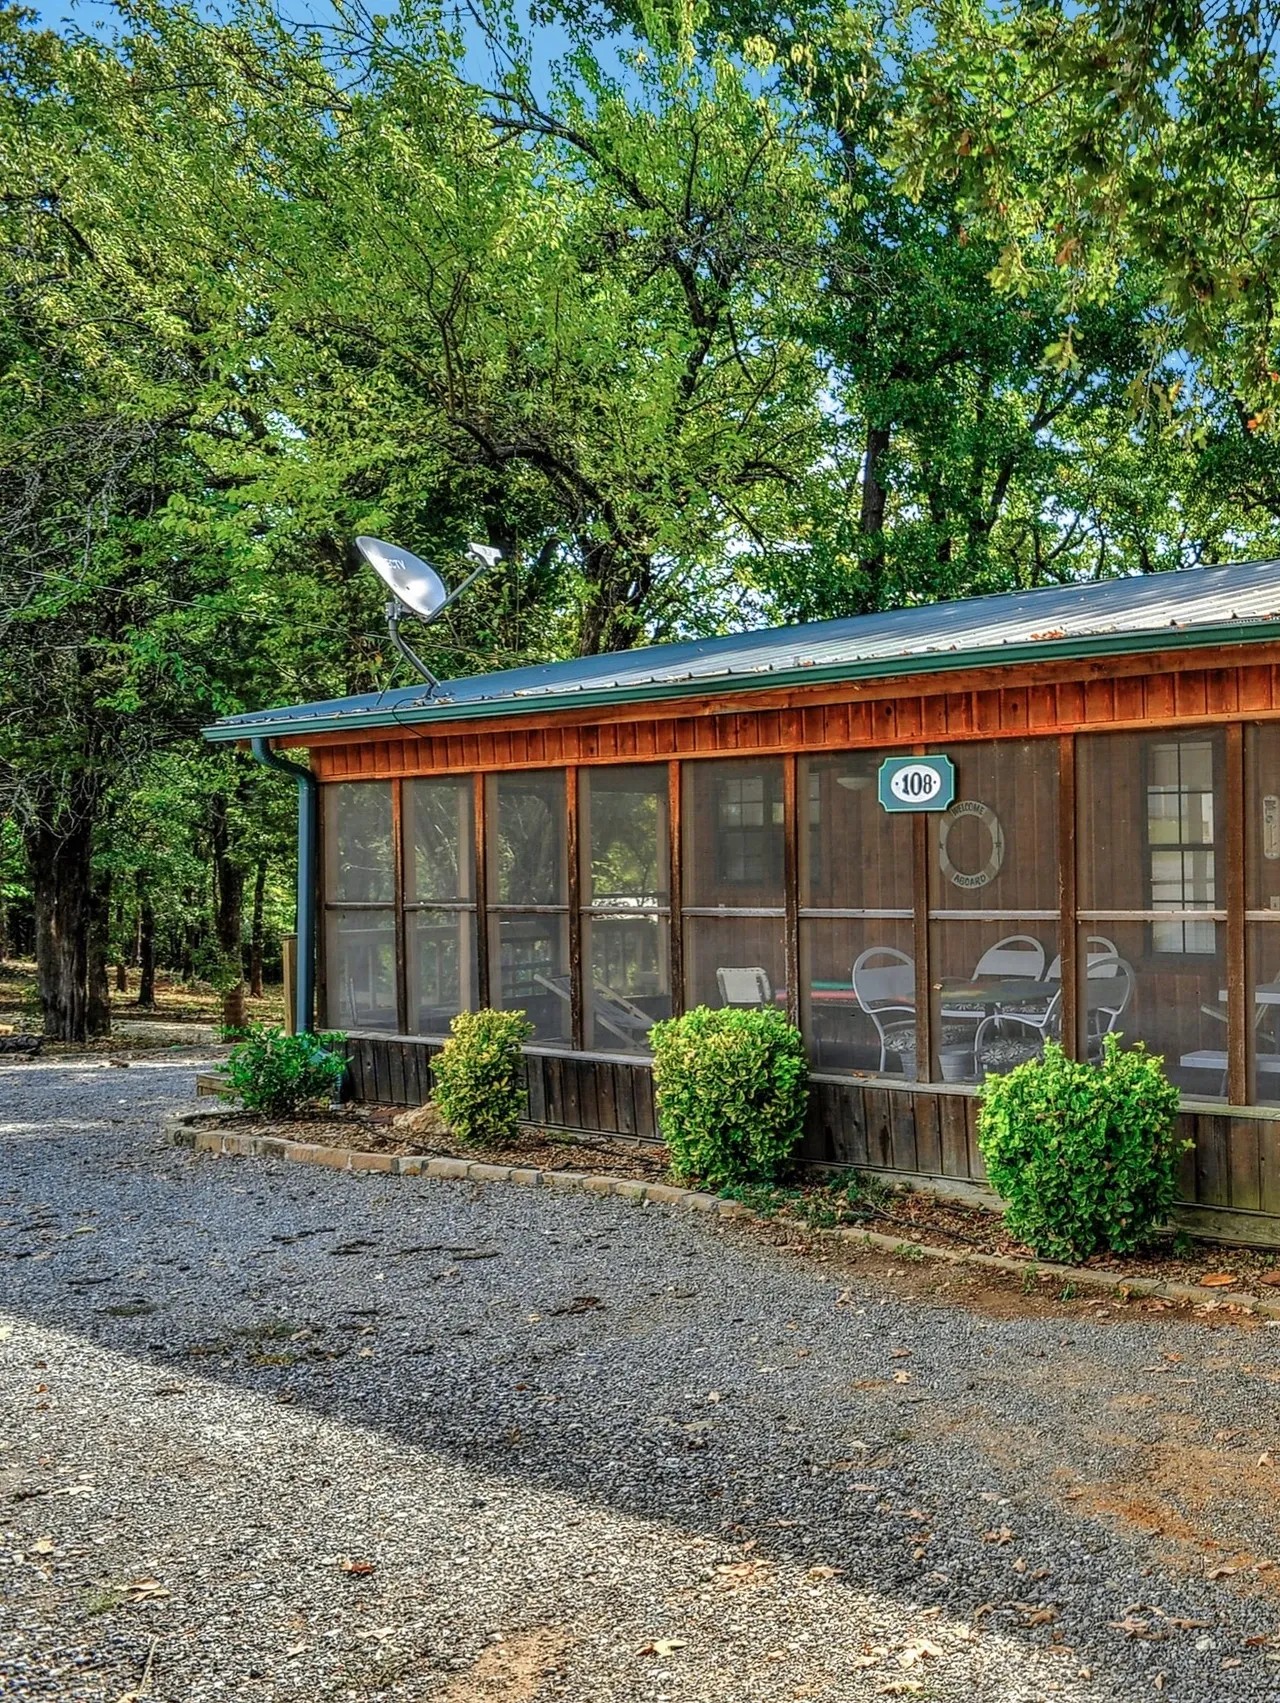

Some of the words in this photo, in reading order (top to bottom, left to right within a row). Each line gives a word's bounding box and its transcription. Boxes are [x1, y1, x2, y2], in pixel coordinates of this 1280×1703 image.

[902, 772, 933, 796] 108
[952, 801, 986, 817] WELCOME
[954, 873, 986, 886] ABOARD
